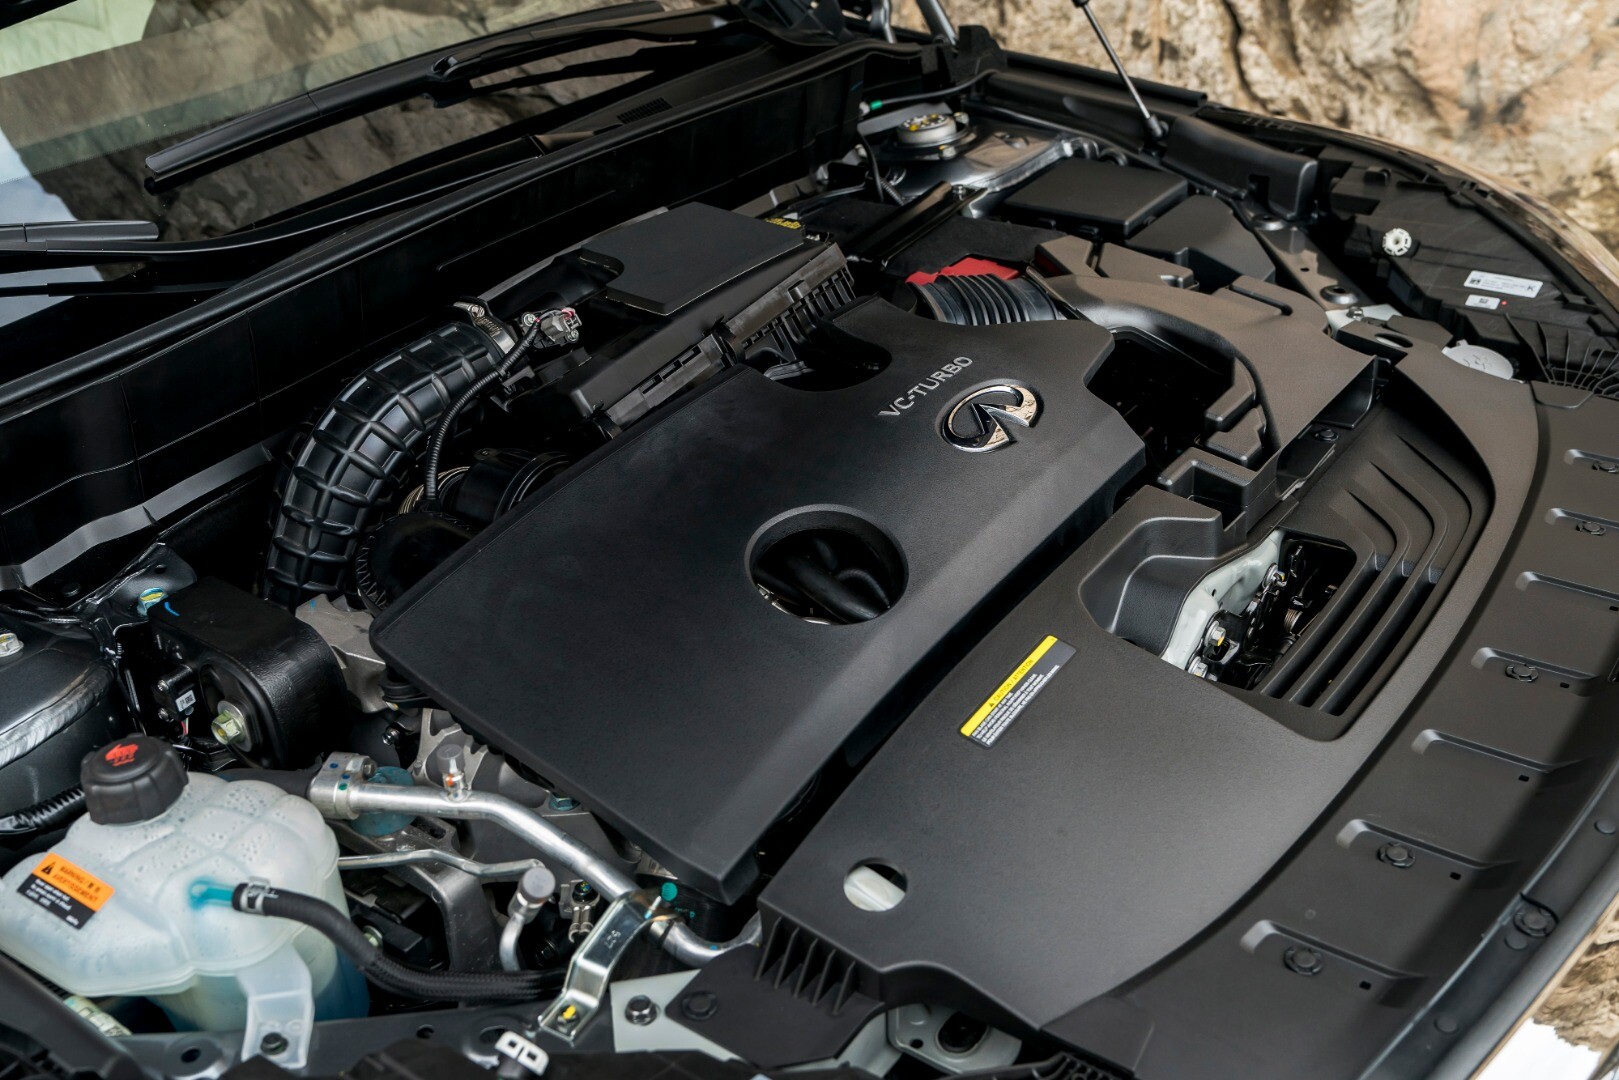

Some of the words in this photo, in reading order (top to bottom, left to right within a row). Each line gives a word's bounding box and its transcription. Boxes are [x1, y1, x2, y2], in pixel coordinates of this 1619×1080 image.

[878, 356, 973, 416] VC-TURBO
[993, 681, 1012, 701] CAUTION
[1012, 659, 1034, 681] ATTENTION
